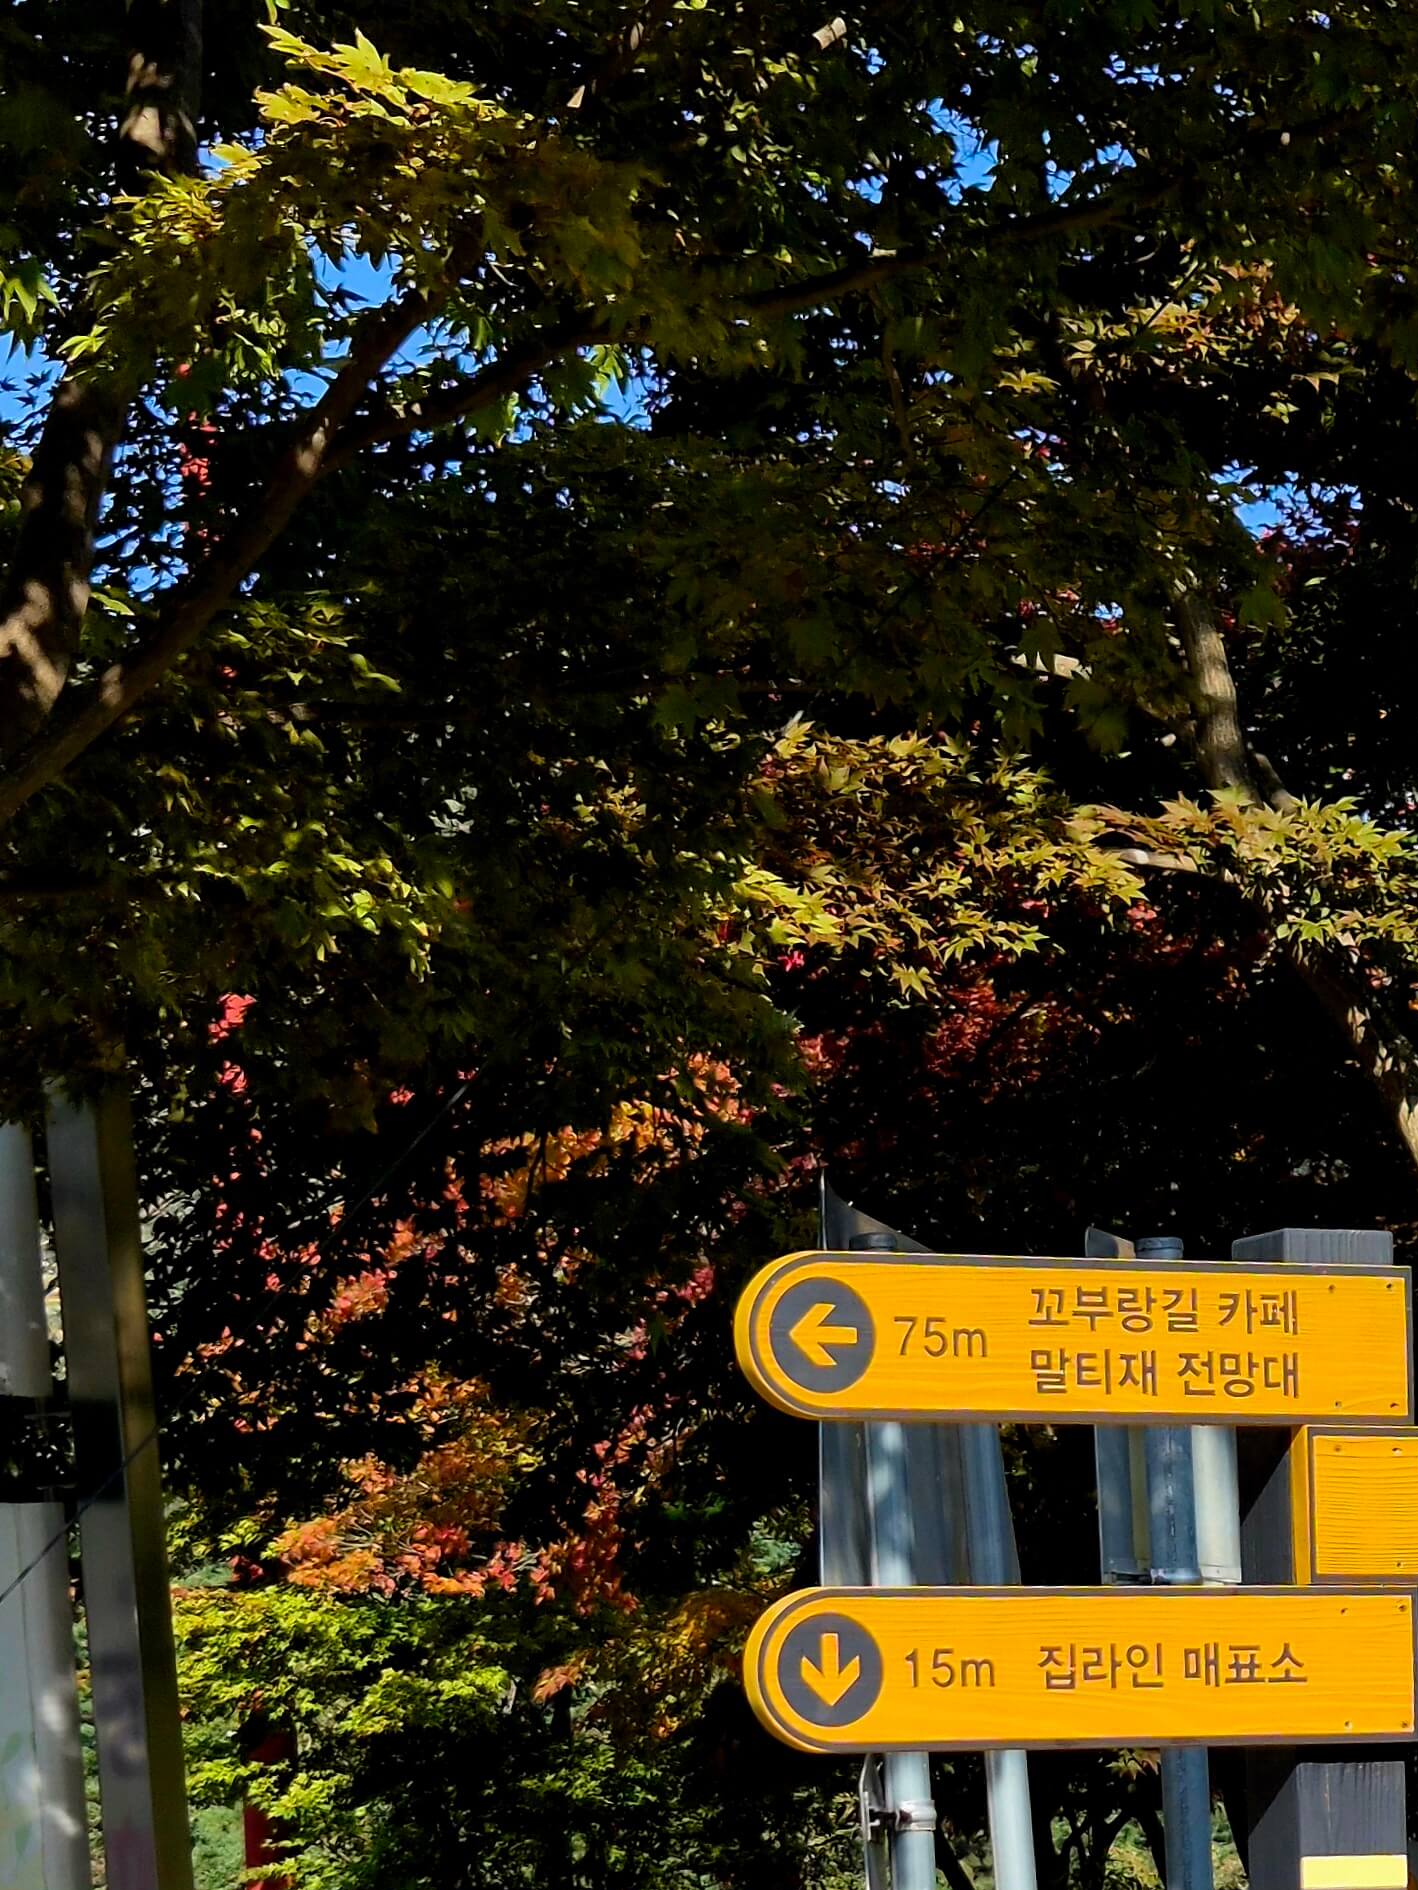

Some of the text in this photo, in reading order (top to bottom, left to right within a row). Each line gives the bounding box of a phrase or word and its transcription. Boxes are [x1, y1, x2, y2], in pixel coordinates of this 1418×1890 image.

[1028, 1286, 1299, 1336] 꼬부랑길 카페
[893, 1316, 988, 1358] 75m
[1030, 1347, 1300, 1399] 말티재 전망대
[904, 1642, 1308, 1690] 15m 집라인 매표소
